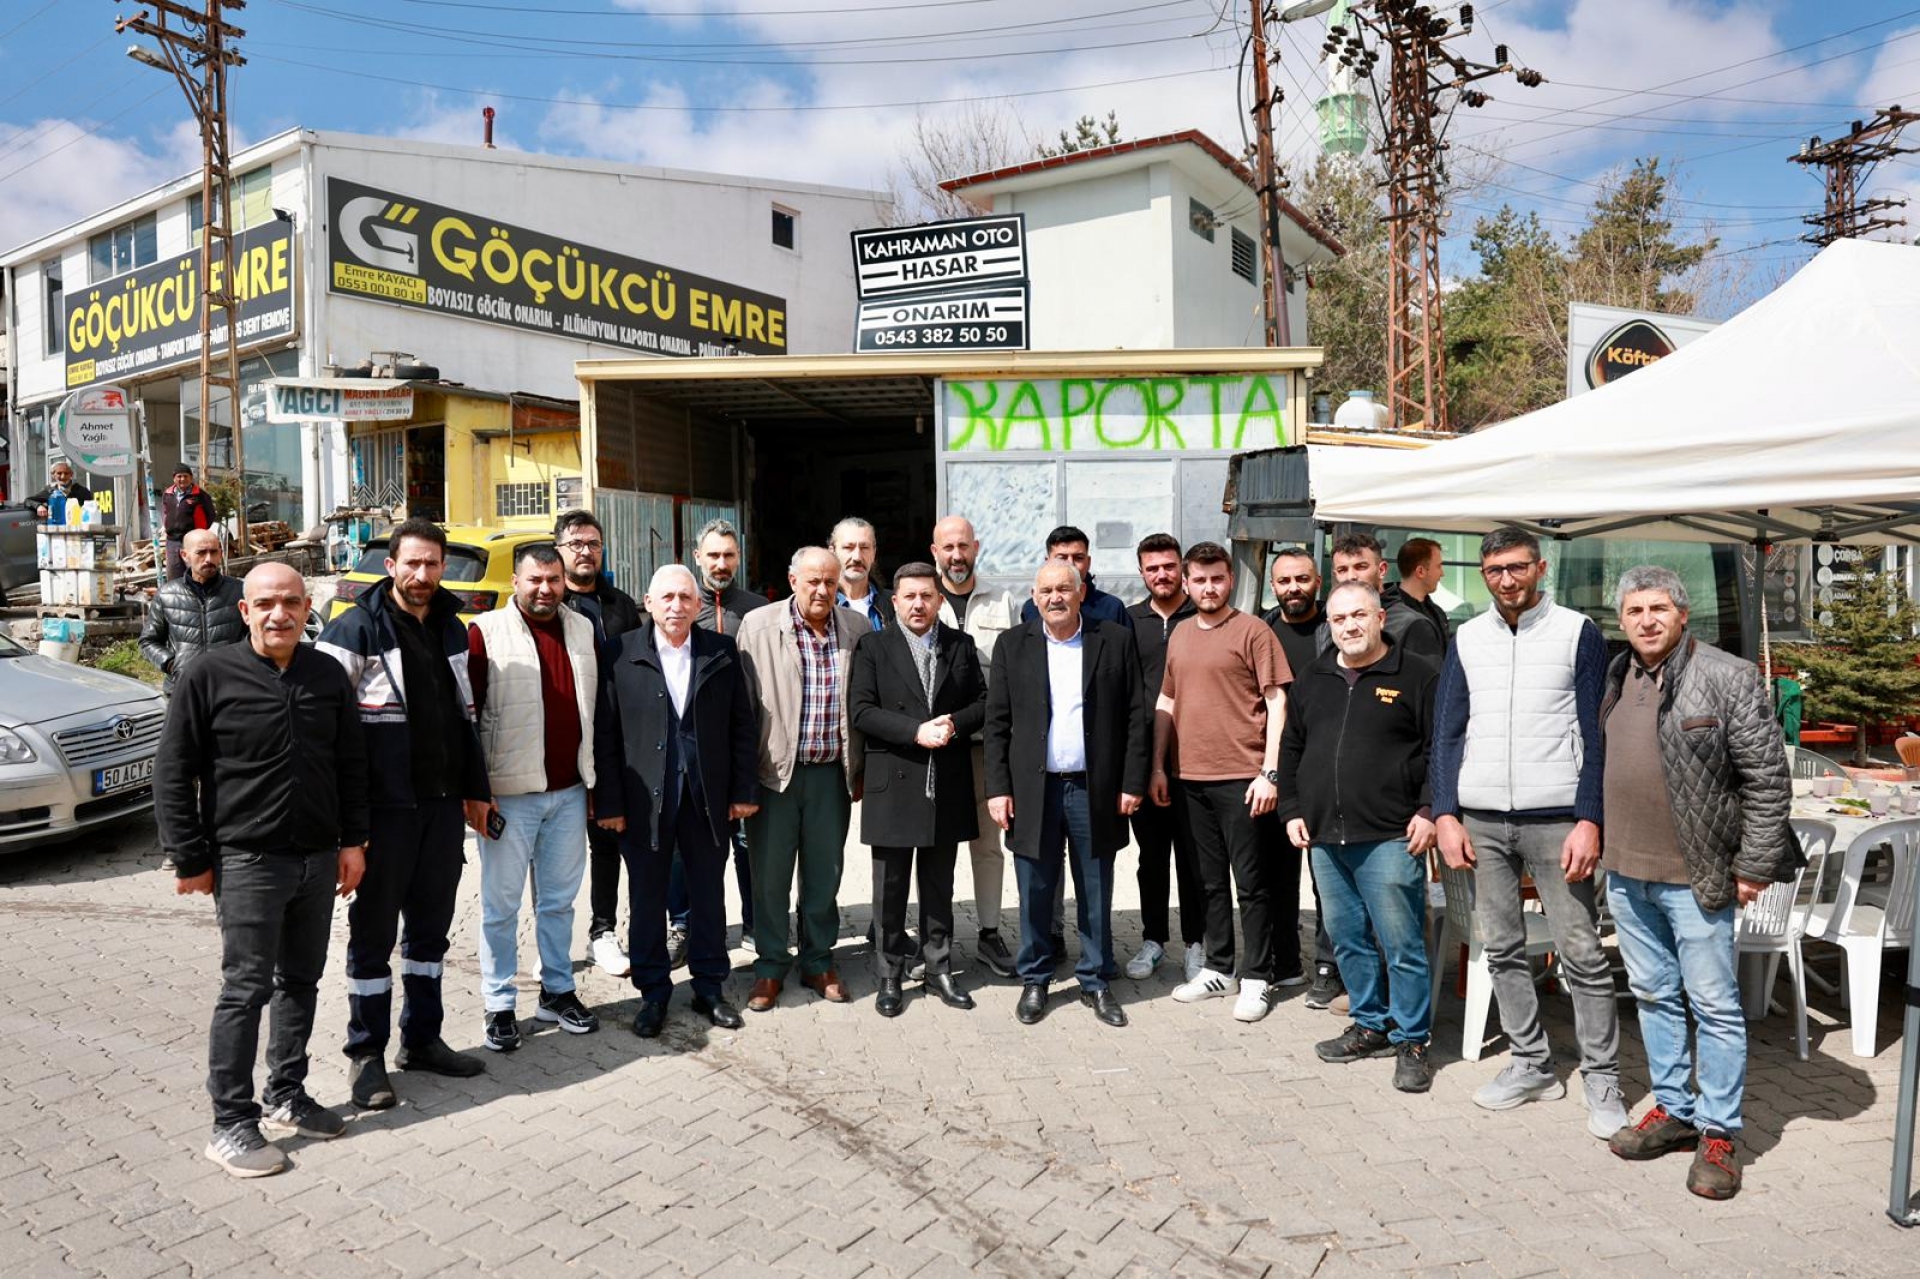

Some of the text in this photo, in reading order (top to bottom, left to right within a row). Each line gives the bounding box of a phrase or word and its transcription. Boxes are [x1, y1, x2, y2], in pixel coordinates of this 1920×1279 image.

[863, 228, 1013, 259] KAHRAMAN OTO
[345, 265, 417, 288] Emre KAYACI
[902, 255, 978, 281] HASAR
[69, 237, 288, 353] GÖÇÜKCÜ EMRE
[338, 276, 423, 302] 0553 001 80 19
[431, 217, 785, 347] GÖÇÜKCÜ EMRE
[243, 316, 261, 336] DENT
[262, 307, 290, 331] REMOVE
[427, 286, 474, 313] BOYASIZ
[476, 294, 512, 321] GÖÇÜK
[514, 304, 553, 328] ONARIM
[563, 313, 618, 341] ALÜMİNYUM
[620, 326, 658, 349] KAPORTA
[660, 335, 691, 355] ONARIM
[892, 302, 990, 323] ONARIM
[874, 326, 1008, 345] 0543 382 50 50
[948, 374, 1286, 451] KAPORTA
[80, 422, 113, 430] Ahmet
[104, 769, 119, 787] 50
[124, 762, 144, 782] ACY
